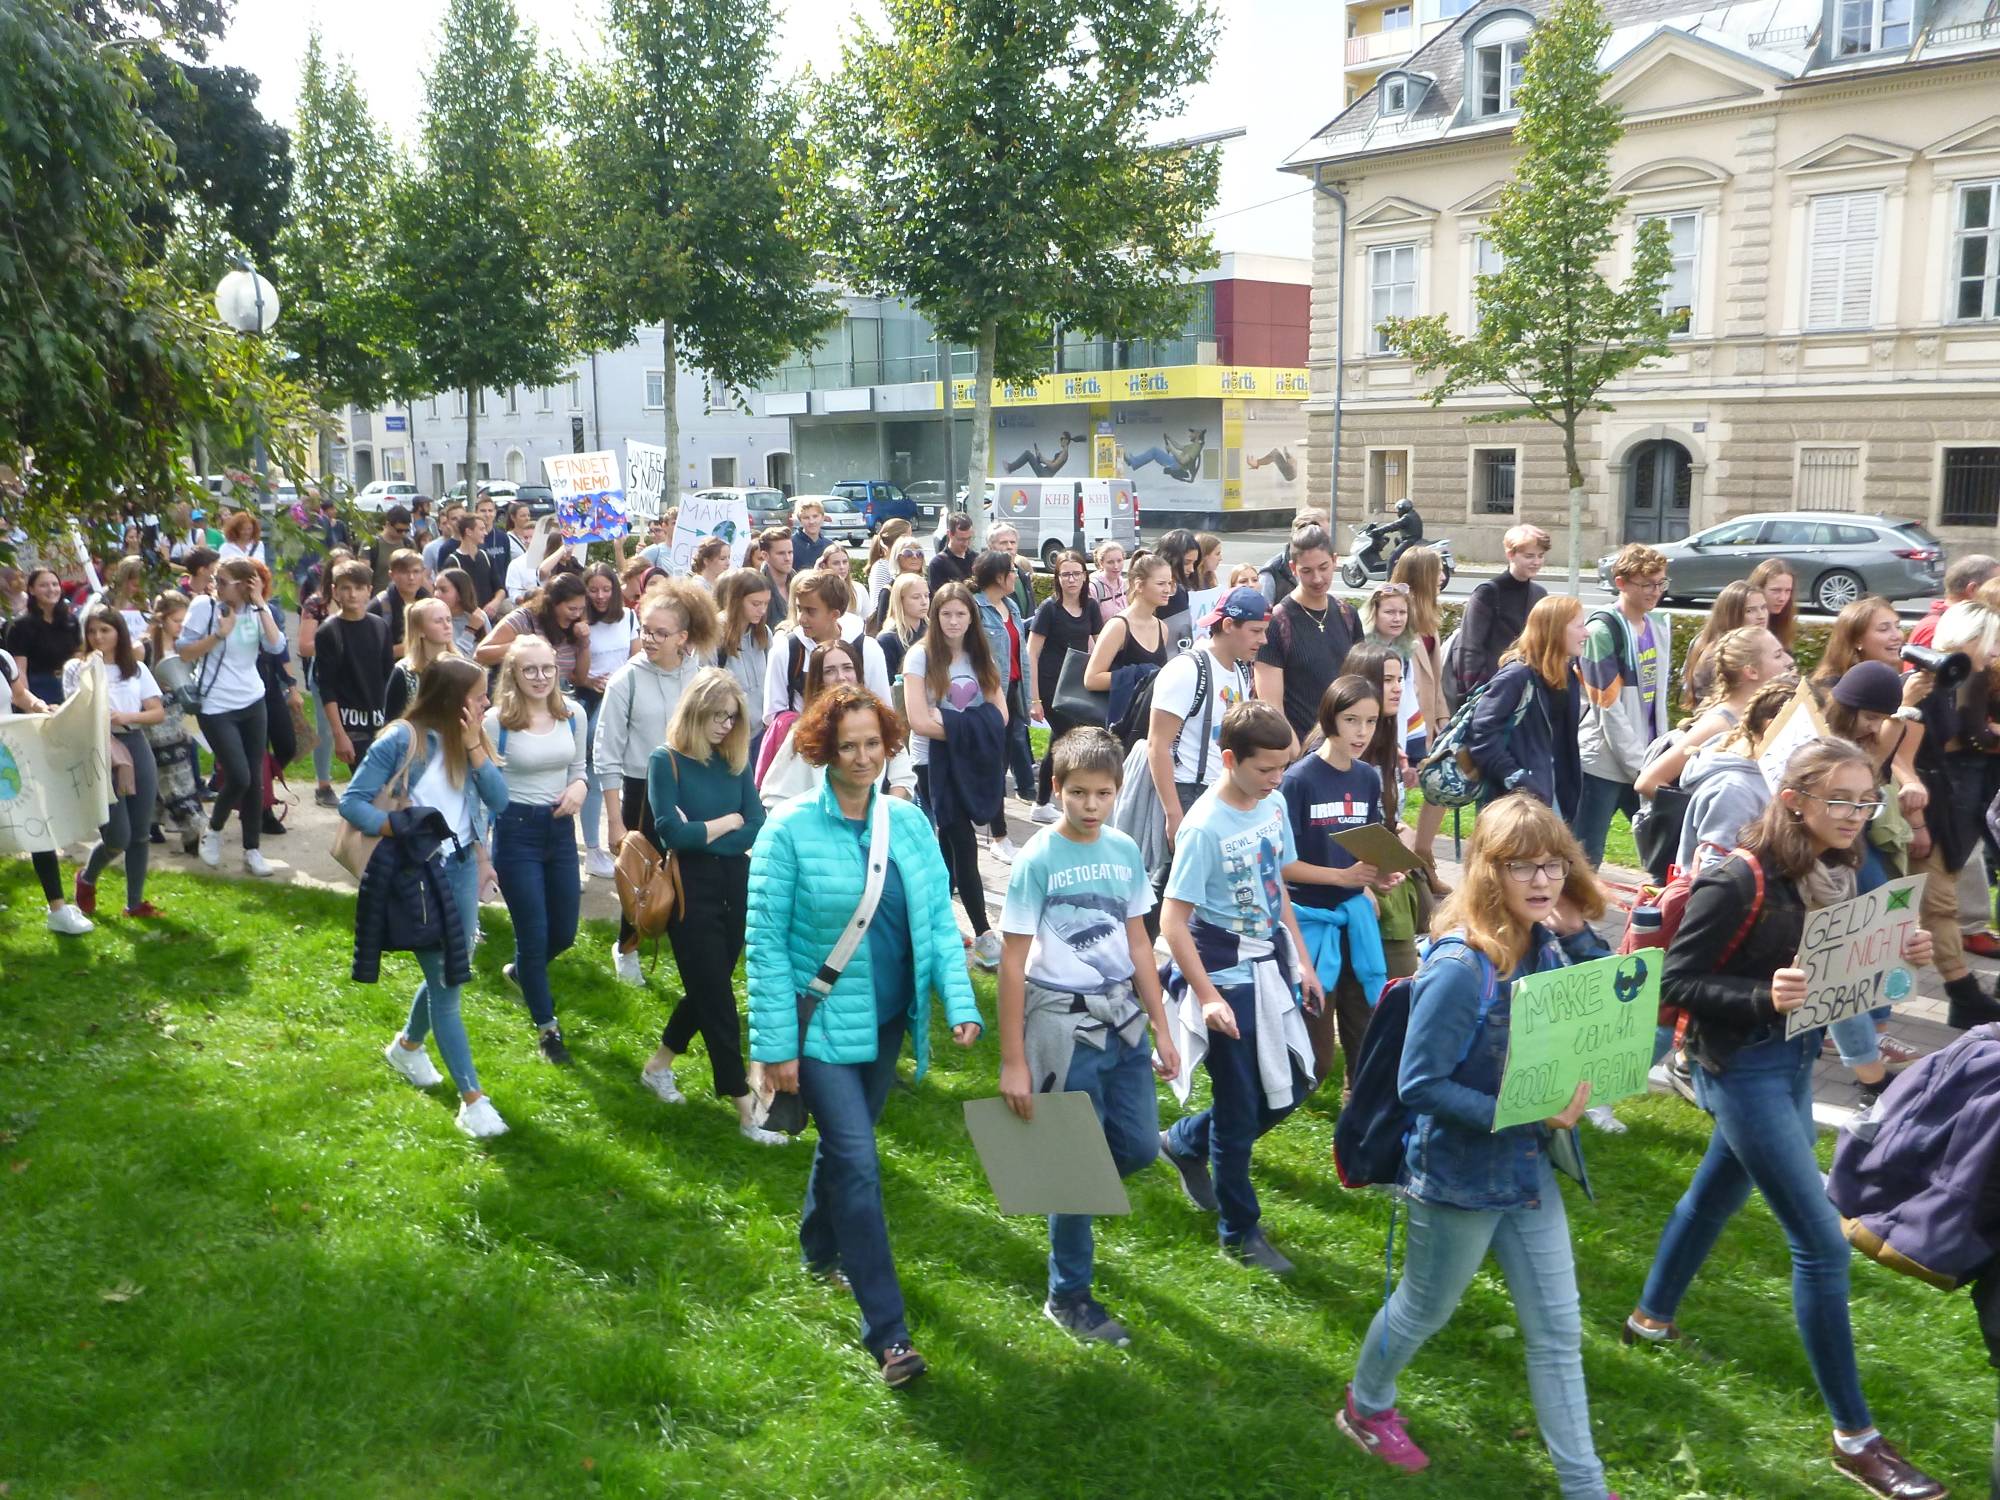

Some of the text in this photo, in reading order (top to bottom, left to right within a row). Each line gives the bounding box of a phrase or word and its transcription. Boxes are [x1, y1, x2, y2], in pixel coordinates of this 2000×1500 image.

[1065, 376, 1101, 394] Hörtis
[1130, 372, 1169, 391] Hörtis
[1221, 371, 1256, 389] Hörtis
[554, 457, 610, 476] FINDET
[573, 475, 610, 491] NEMO
[640, 466, 664, 493] NOT
[1045, 493, 1070, 505] KHB
[1089, 493, 1109, 504] KHB
[681, 499, 734, 521] MAKE
[340, 707, 368, 726] YOU
[1225, 837, 1253, 853] BOWL
[1073, 865, 1090, 883] TO
[1091, 864, 1111, 880] EAT
[1804, 895, 1877, 950] GELD
[1806, 920, 1914, 984] ST NICHT
[1524, 970, 1603, 1035] MAKE
[1789, 970, 1884, 1036] ESSBAR!
[1502, 1048, 1650, 1111] COOL AGAIN
